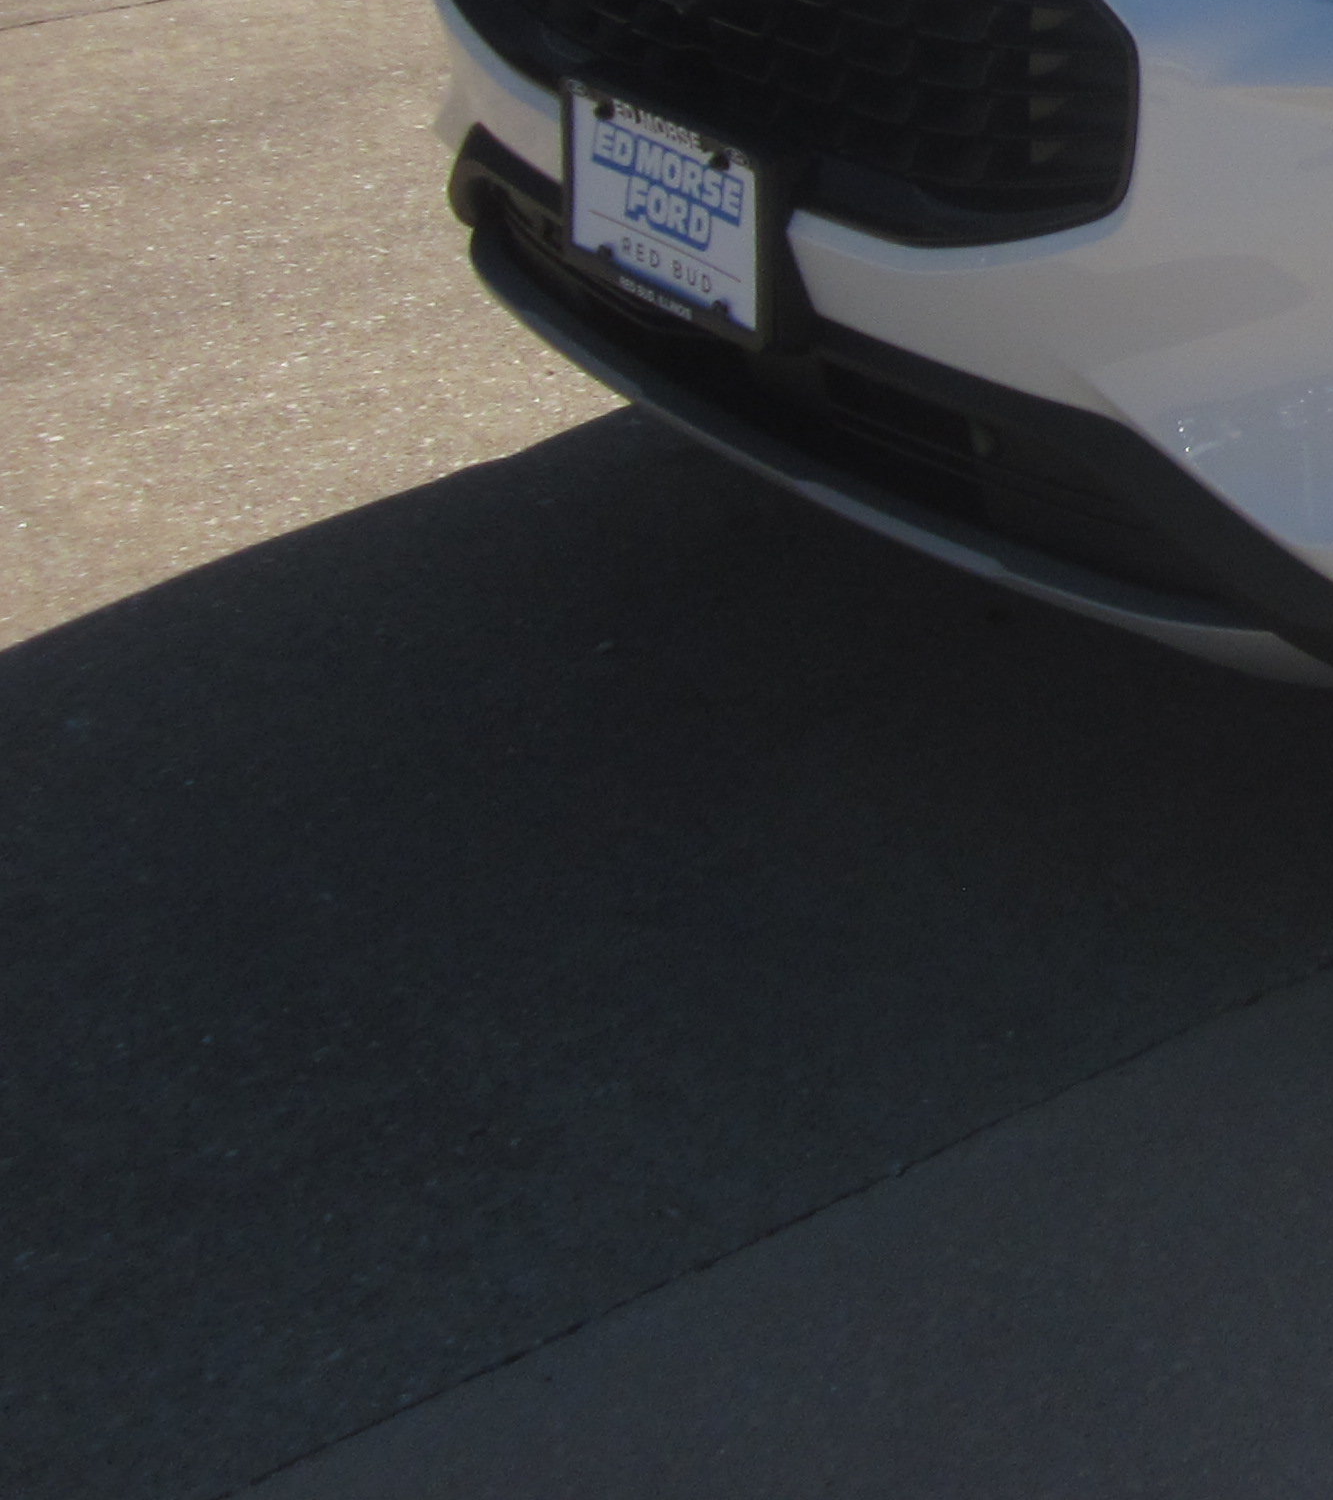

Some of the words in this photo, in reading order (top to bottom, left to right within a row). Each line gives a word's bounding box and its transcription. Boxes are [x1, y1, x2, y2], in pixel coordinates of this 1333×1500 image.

[636, 109, 700, 150] MORSE
[595, 120, 637, 170] ED
[634, 133, 744, 222] MORSE
[627, 176, 712, 250] FORD
[621, 236, 661, 269] RED
[672, 259, 712, 294] BUD
